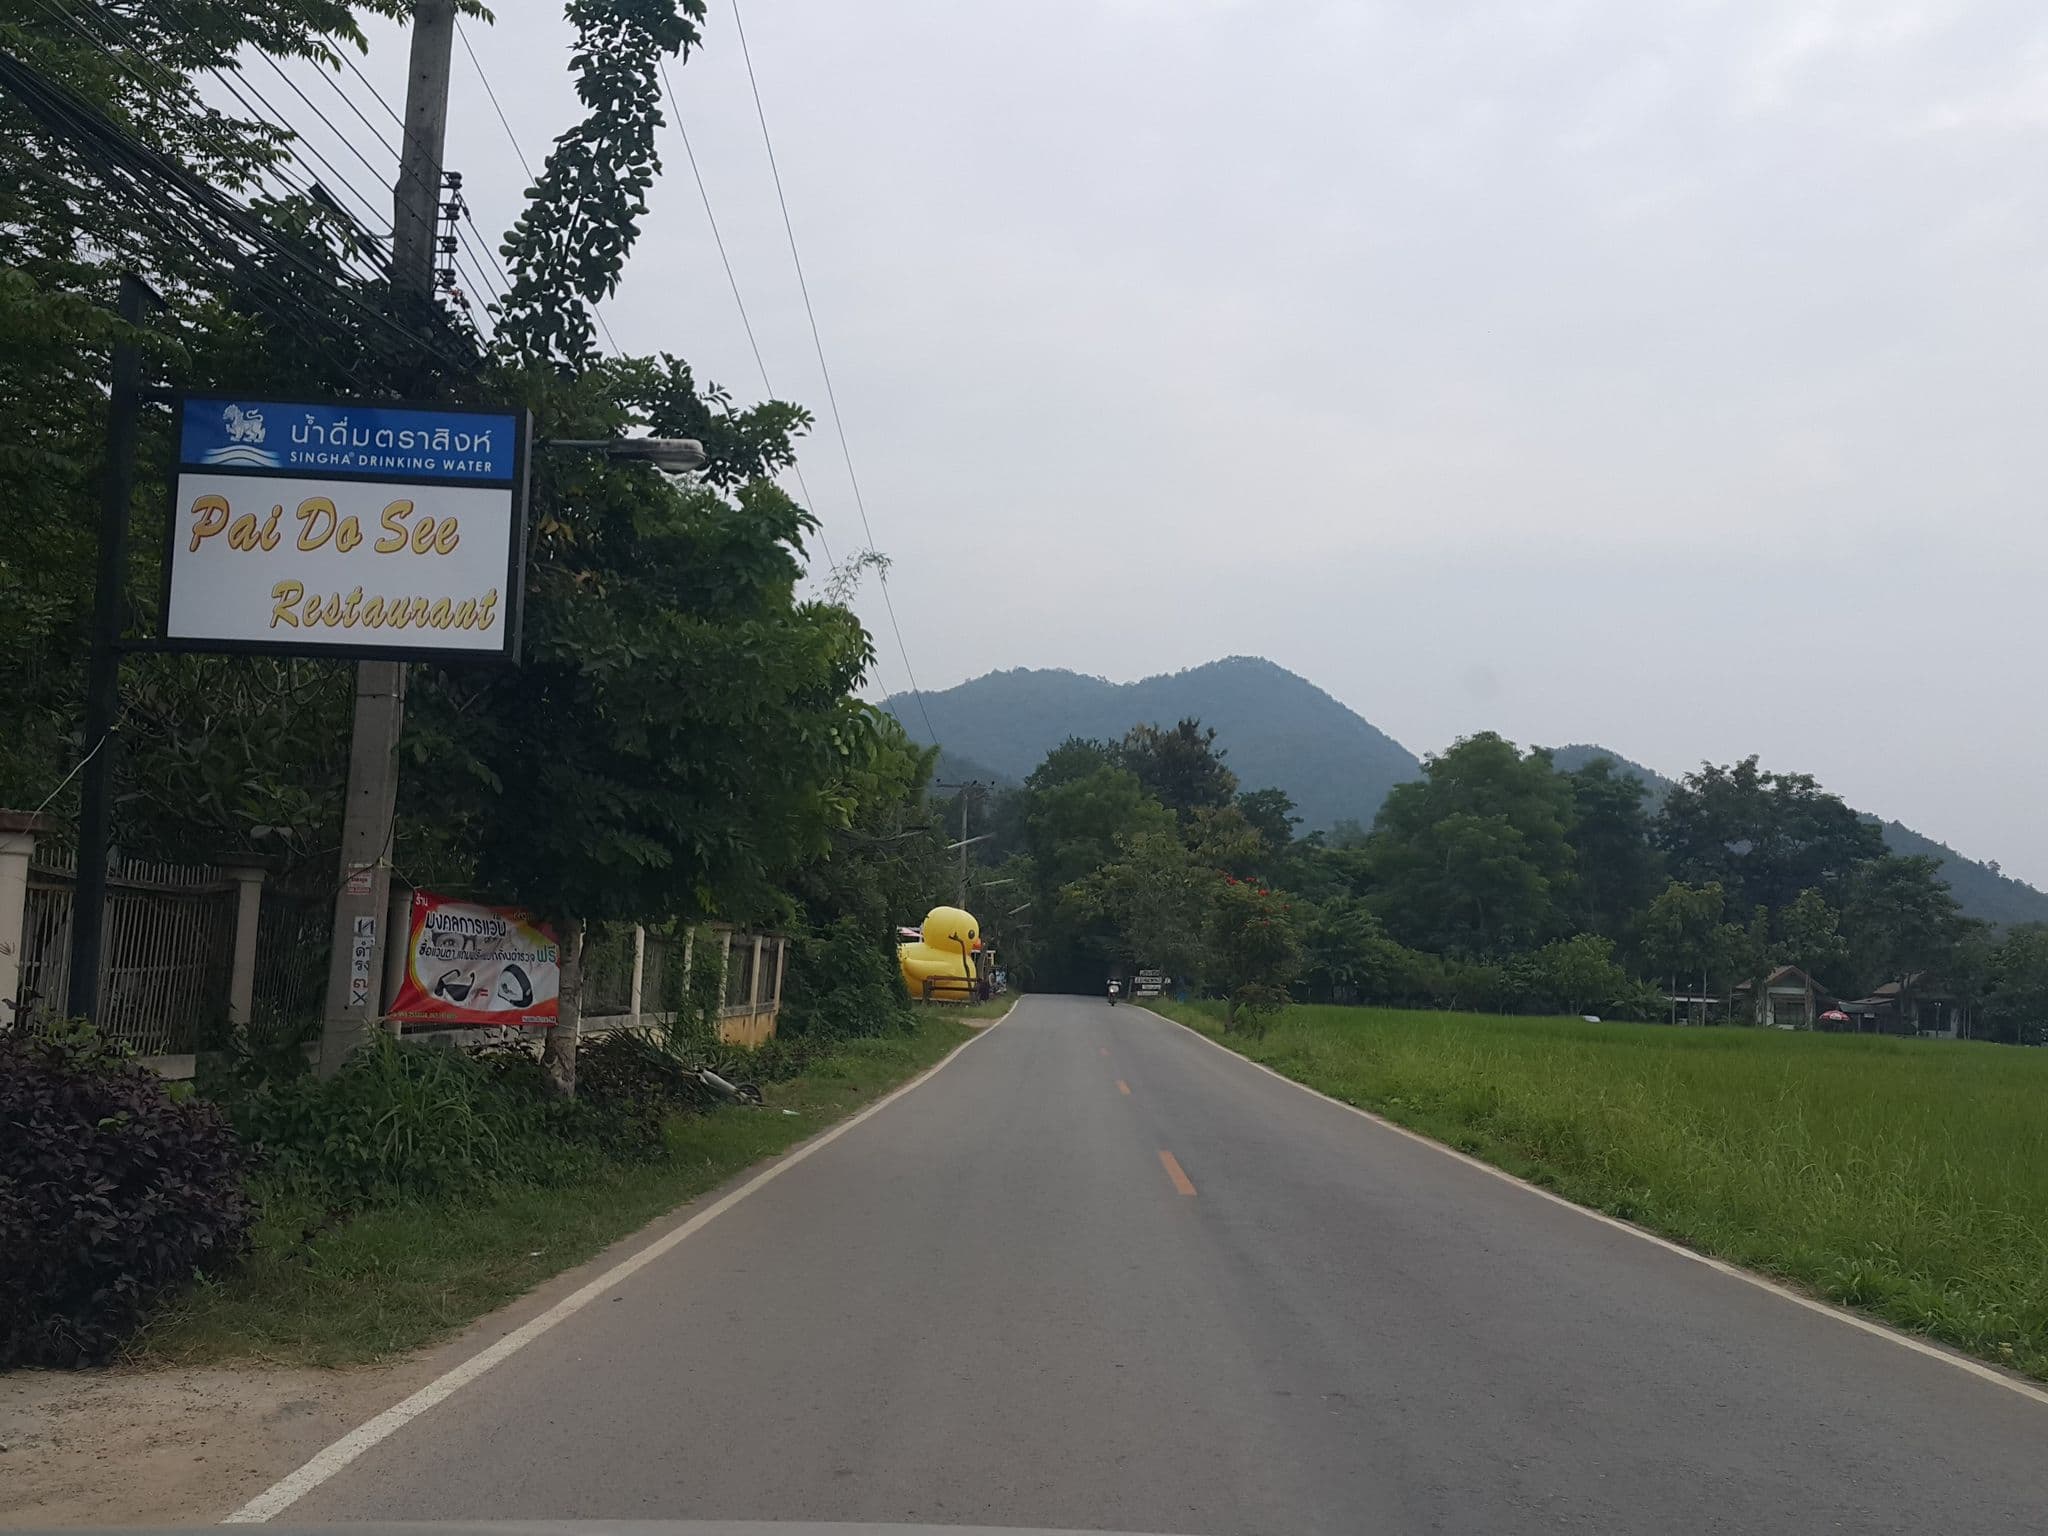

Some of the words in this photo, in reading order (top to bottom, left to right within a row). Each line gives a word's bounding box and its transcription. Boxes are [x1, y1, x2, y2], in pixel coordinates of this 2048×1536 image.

[291, 414, 493, 454] น้ำดื่มตราสิงห์
[290, 451, 351, 465] SINGHA
[358, 454, 436, 469] DRINKING
[443, 460, 493, 472] WATER
[189, 494, 281, 552] Pai
[296, 497, 363, 553] Do
[374, 499, 460, 555] See
[270, 579, 498, 631] Restaurant
